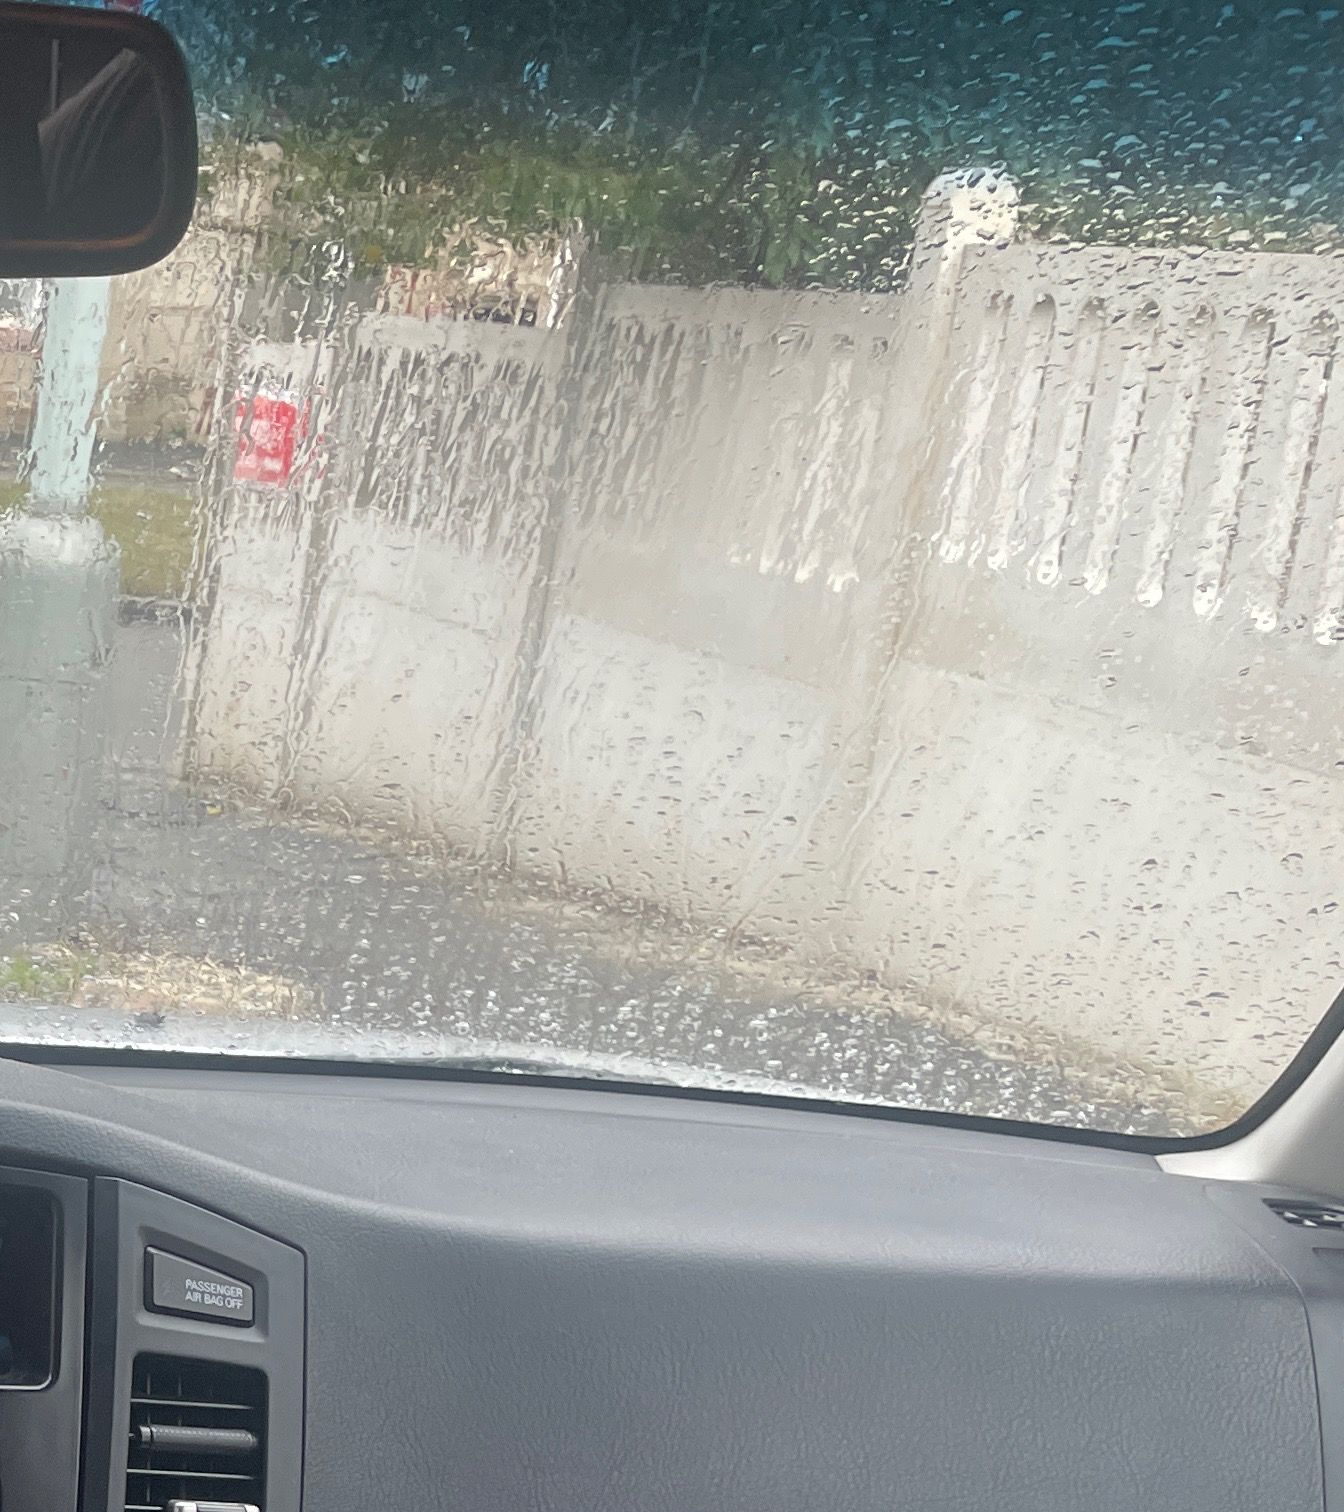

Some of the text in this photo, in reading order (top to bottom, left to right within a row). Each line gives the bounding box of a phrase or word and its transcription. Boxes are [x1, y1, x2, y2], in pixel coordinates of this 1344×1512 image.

[185, 1279, 243, 1297] PASSENGER
[185, 1290, 243, 1310] AIR BAG OFF
